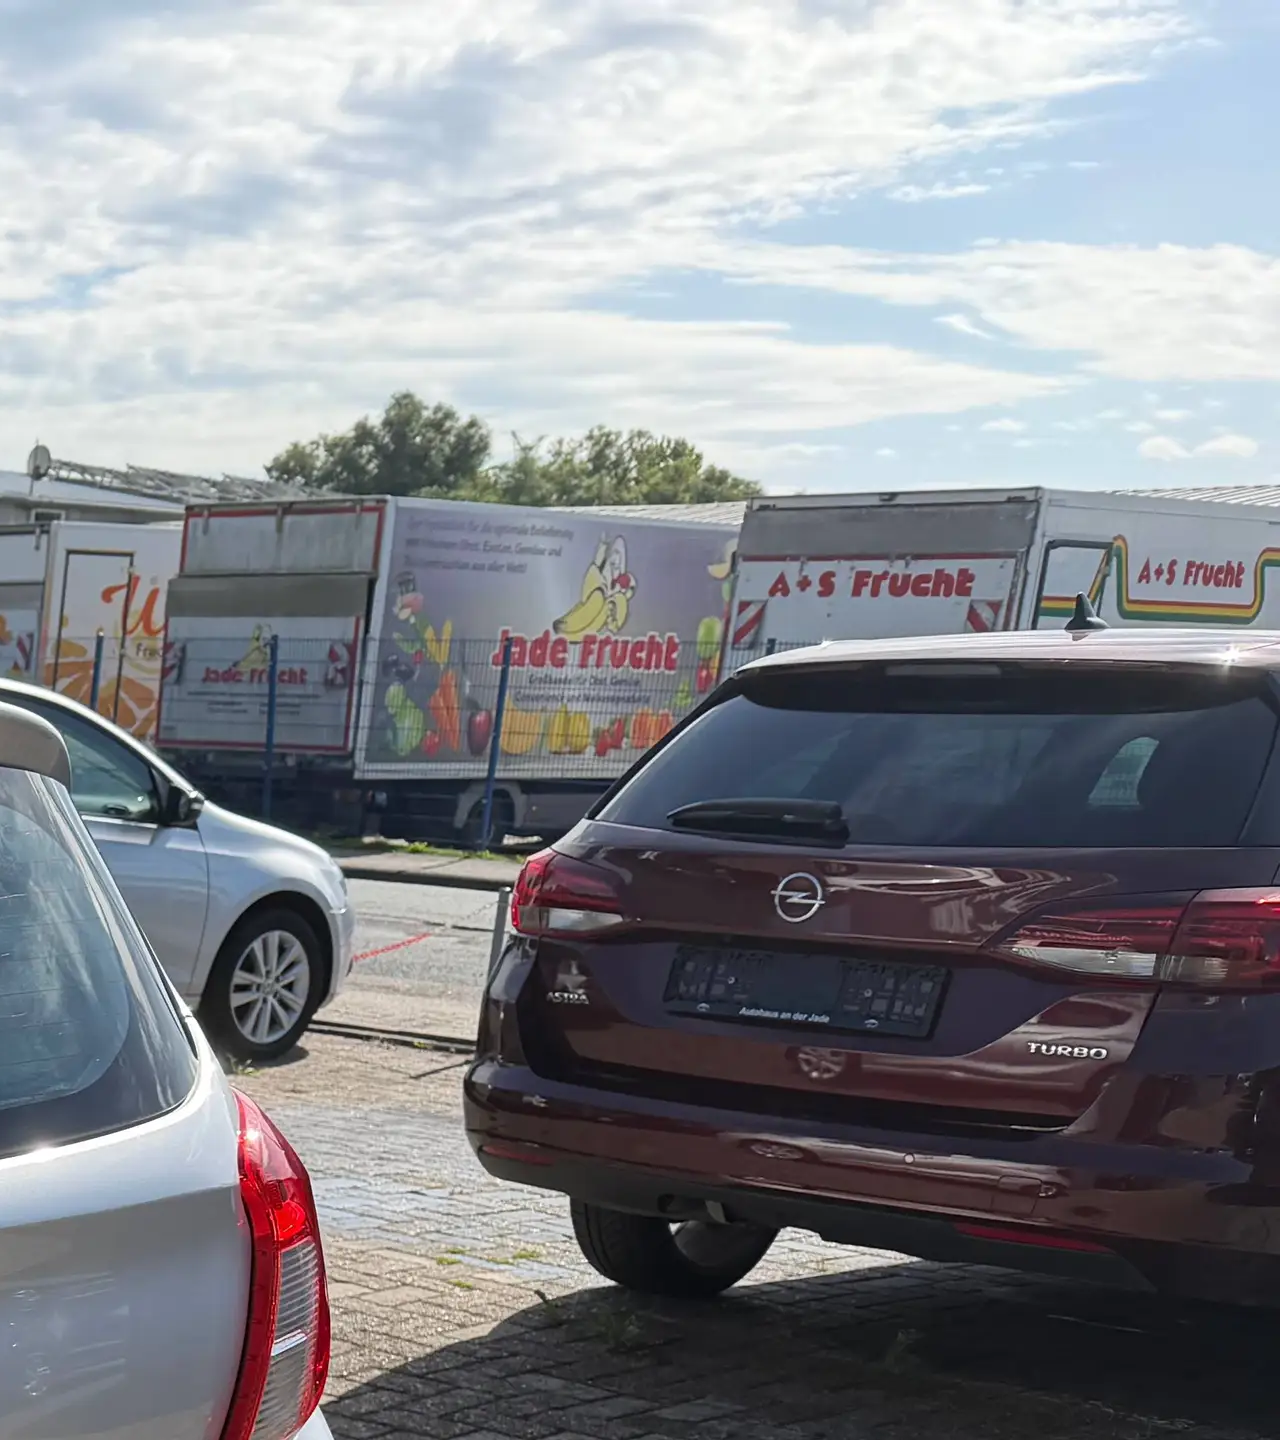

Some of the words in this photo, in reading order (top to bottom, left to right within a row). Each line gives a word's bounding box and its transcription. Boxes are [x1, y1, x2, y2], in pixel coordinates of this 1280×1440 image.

[851, 567, 976, 598] Frucht
[1183, 559, 1246, 588] Frucht
[491, 629, 570, 669] Jade
[579, 633, 681, 672] Frucht
[545, 991, 590, 1005] ASTRA
[738, 1006, 779, 1019] Autohaus
[1027, 1041, 1108, 1060] TURBO
